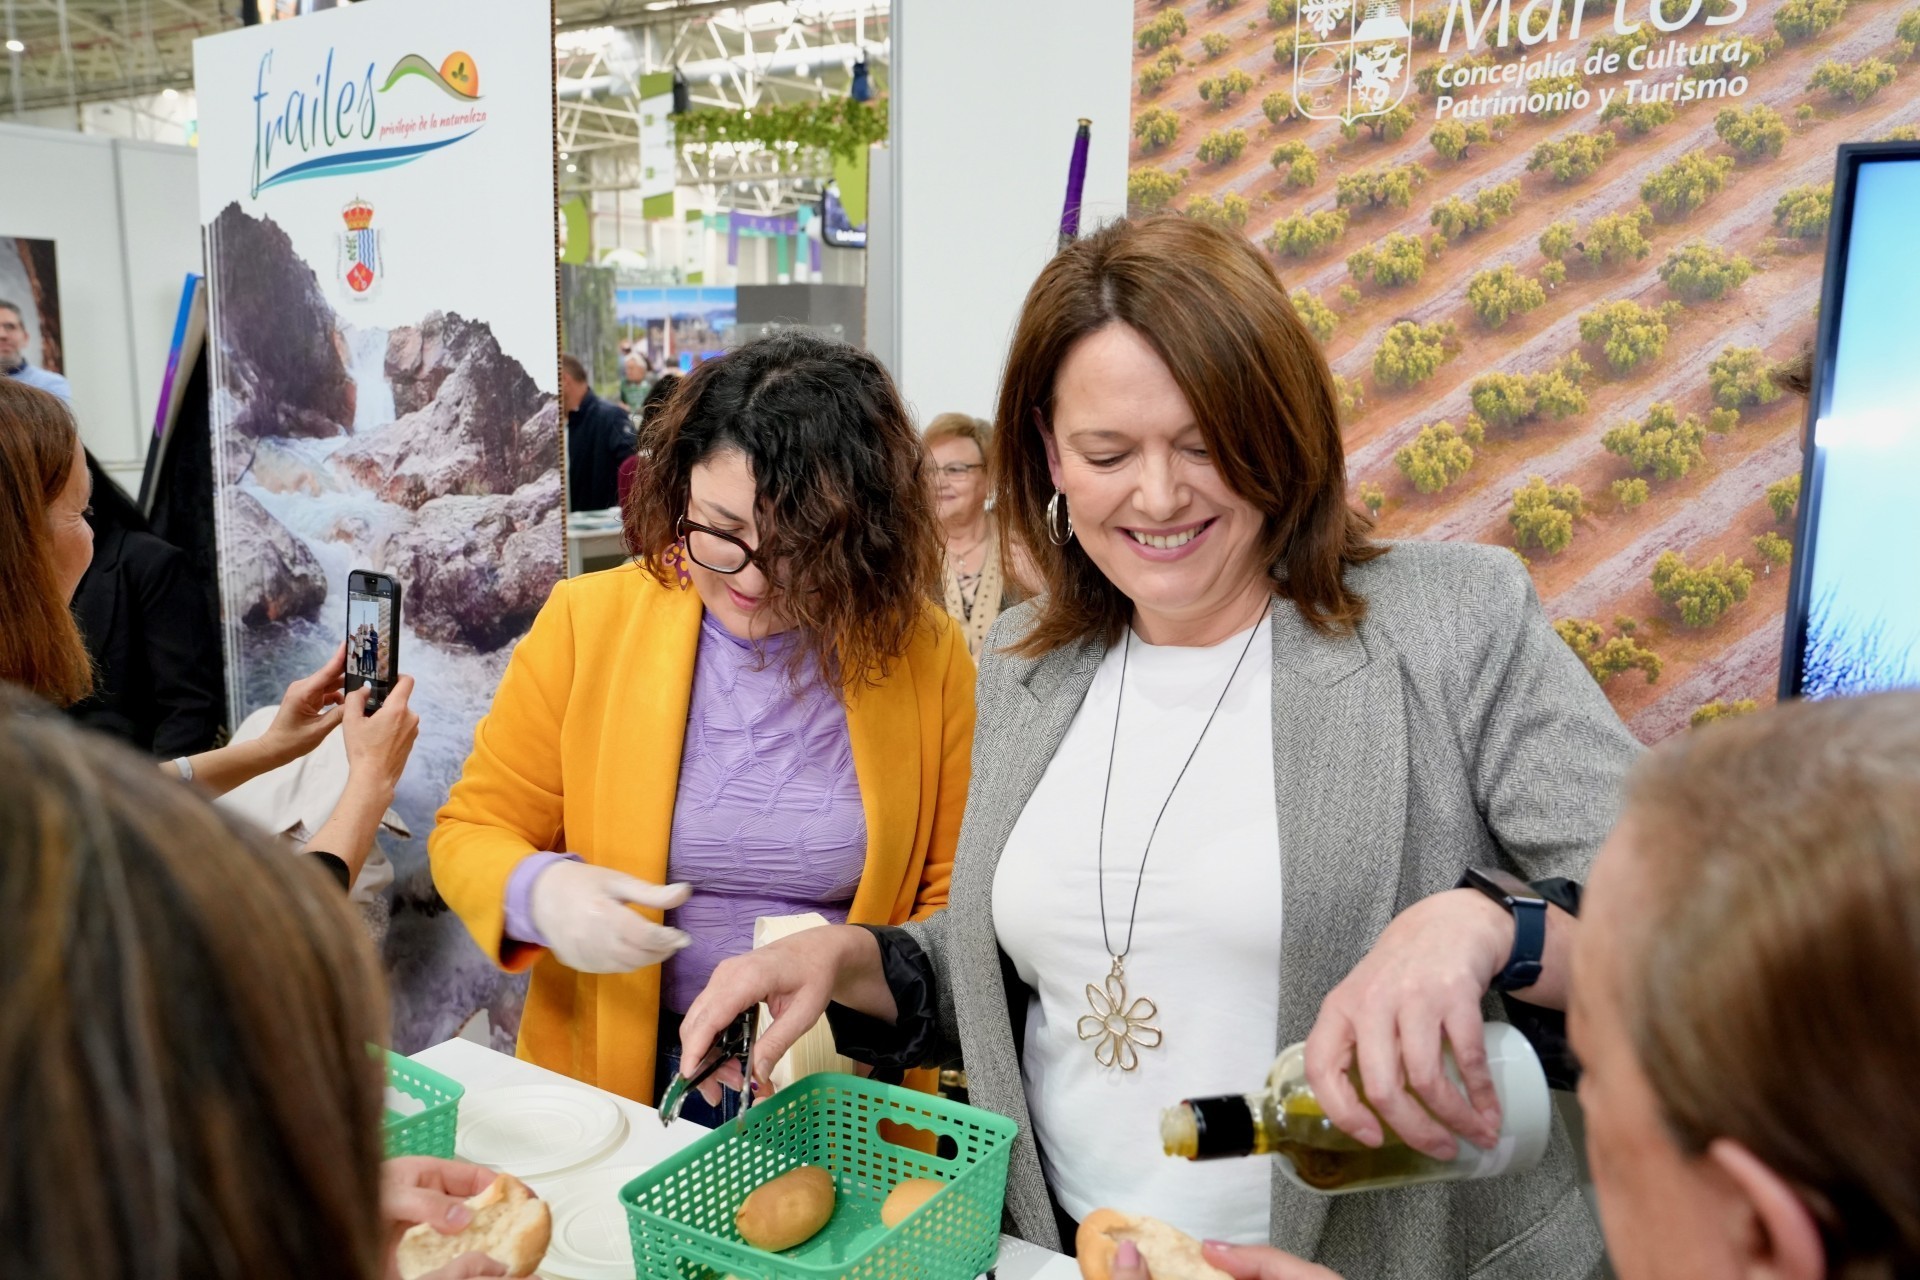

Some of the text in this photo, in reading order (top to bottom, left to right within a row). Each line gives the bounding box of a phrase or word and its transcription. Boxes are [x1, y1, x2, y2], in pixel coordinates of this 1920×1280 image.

[1436, 40, 1750, 88] Concejalía de Cultura,
[1435, 74, 1749, 119] Patrimonio y Turismo
[250, 46, 375, 200] frailes
[379, 107, 487, 141] privilegio de la naturaleza
